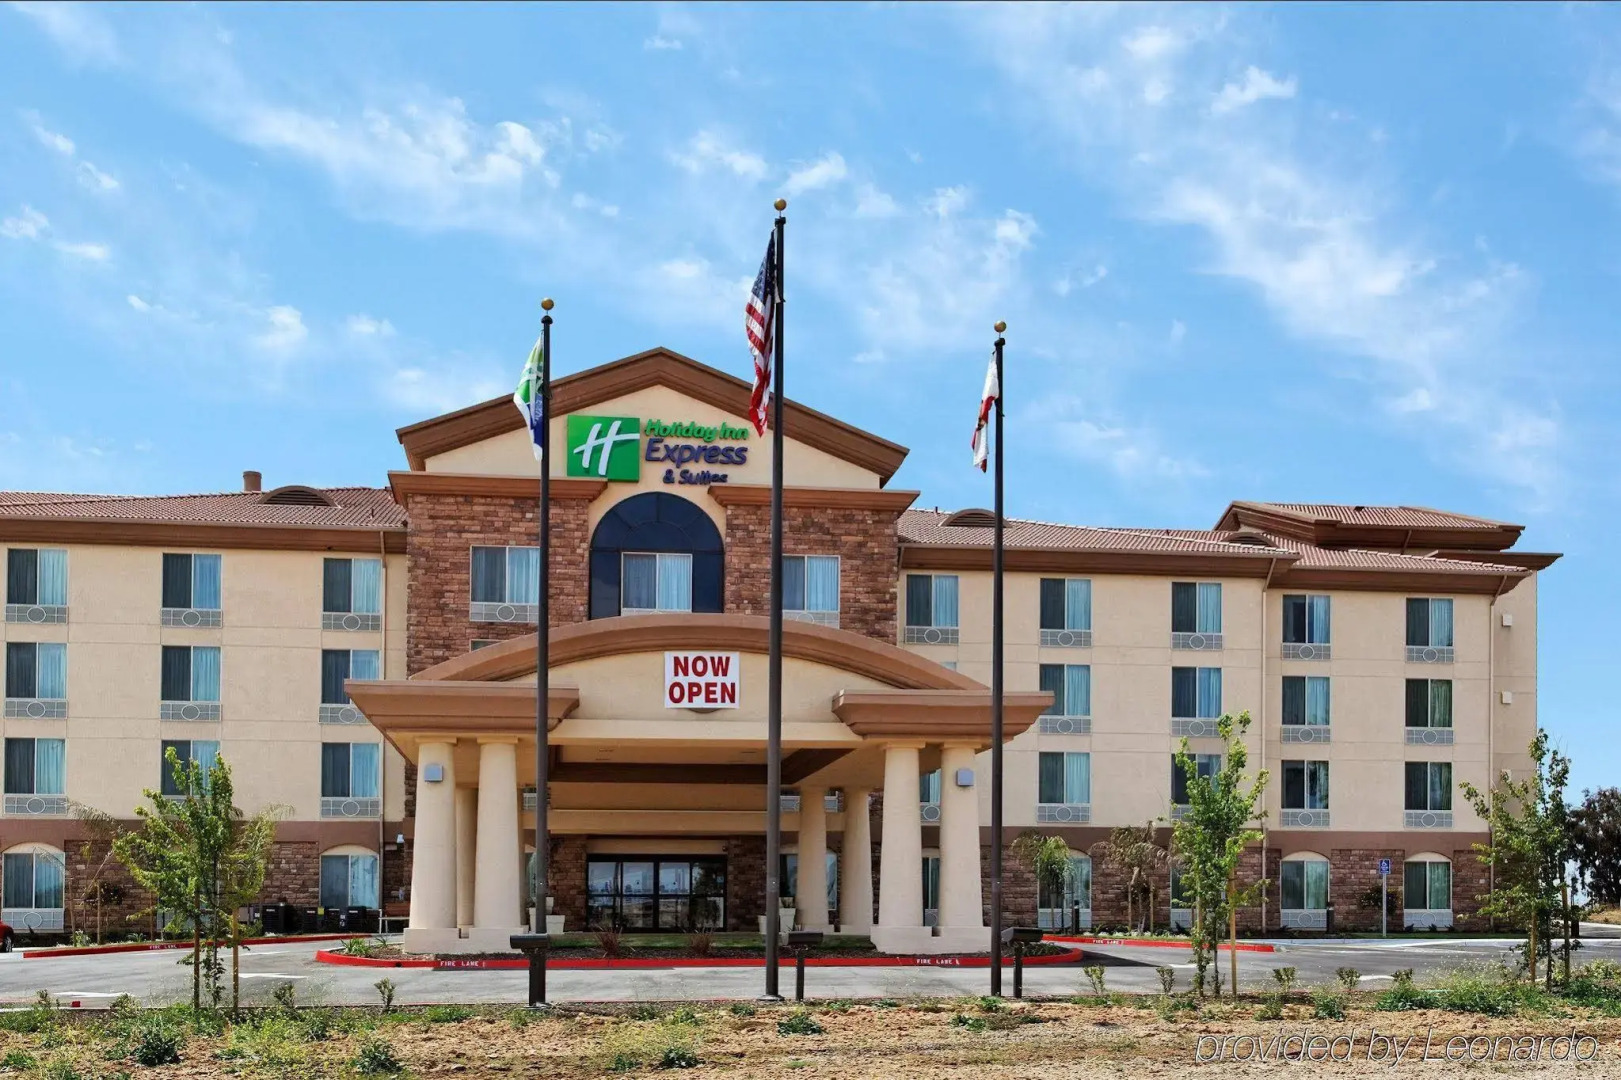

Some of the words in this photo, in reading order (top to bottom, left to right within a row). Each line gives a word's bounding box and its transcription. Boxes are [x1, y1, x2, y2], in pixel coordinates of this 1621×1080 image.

[645, 419, 718, 442] Holiday
[719, 422, 749, 440] Inn
[645, 438, 748, 468] Express
[663, 469, 675, 484] &
[678, 469, 728, 485] Suites
[673, 656, 731, 677] NOW
[668, 682, 736, 704] OPEN
